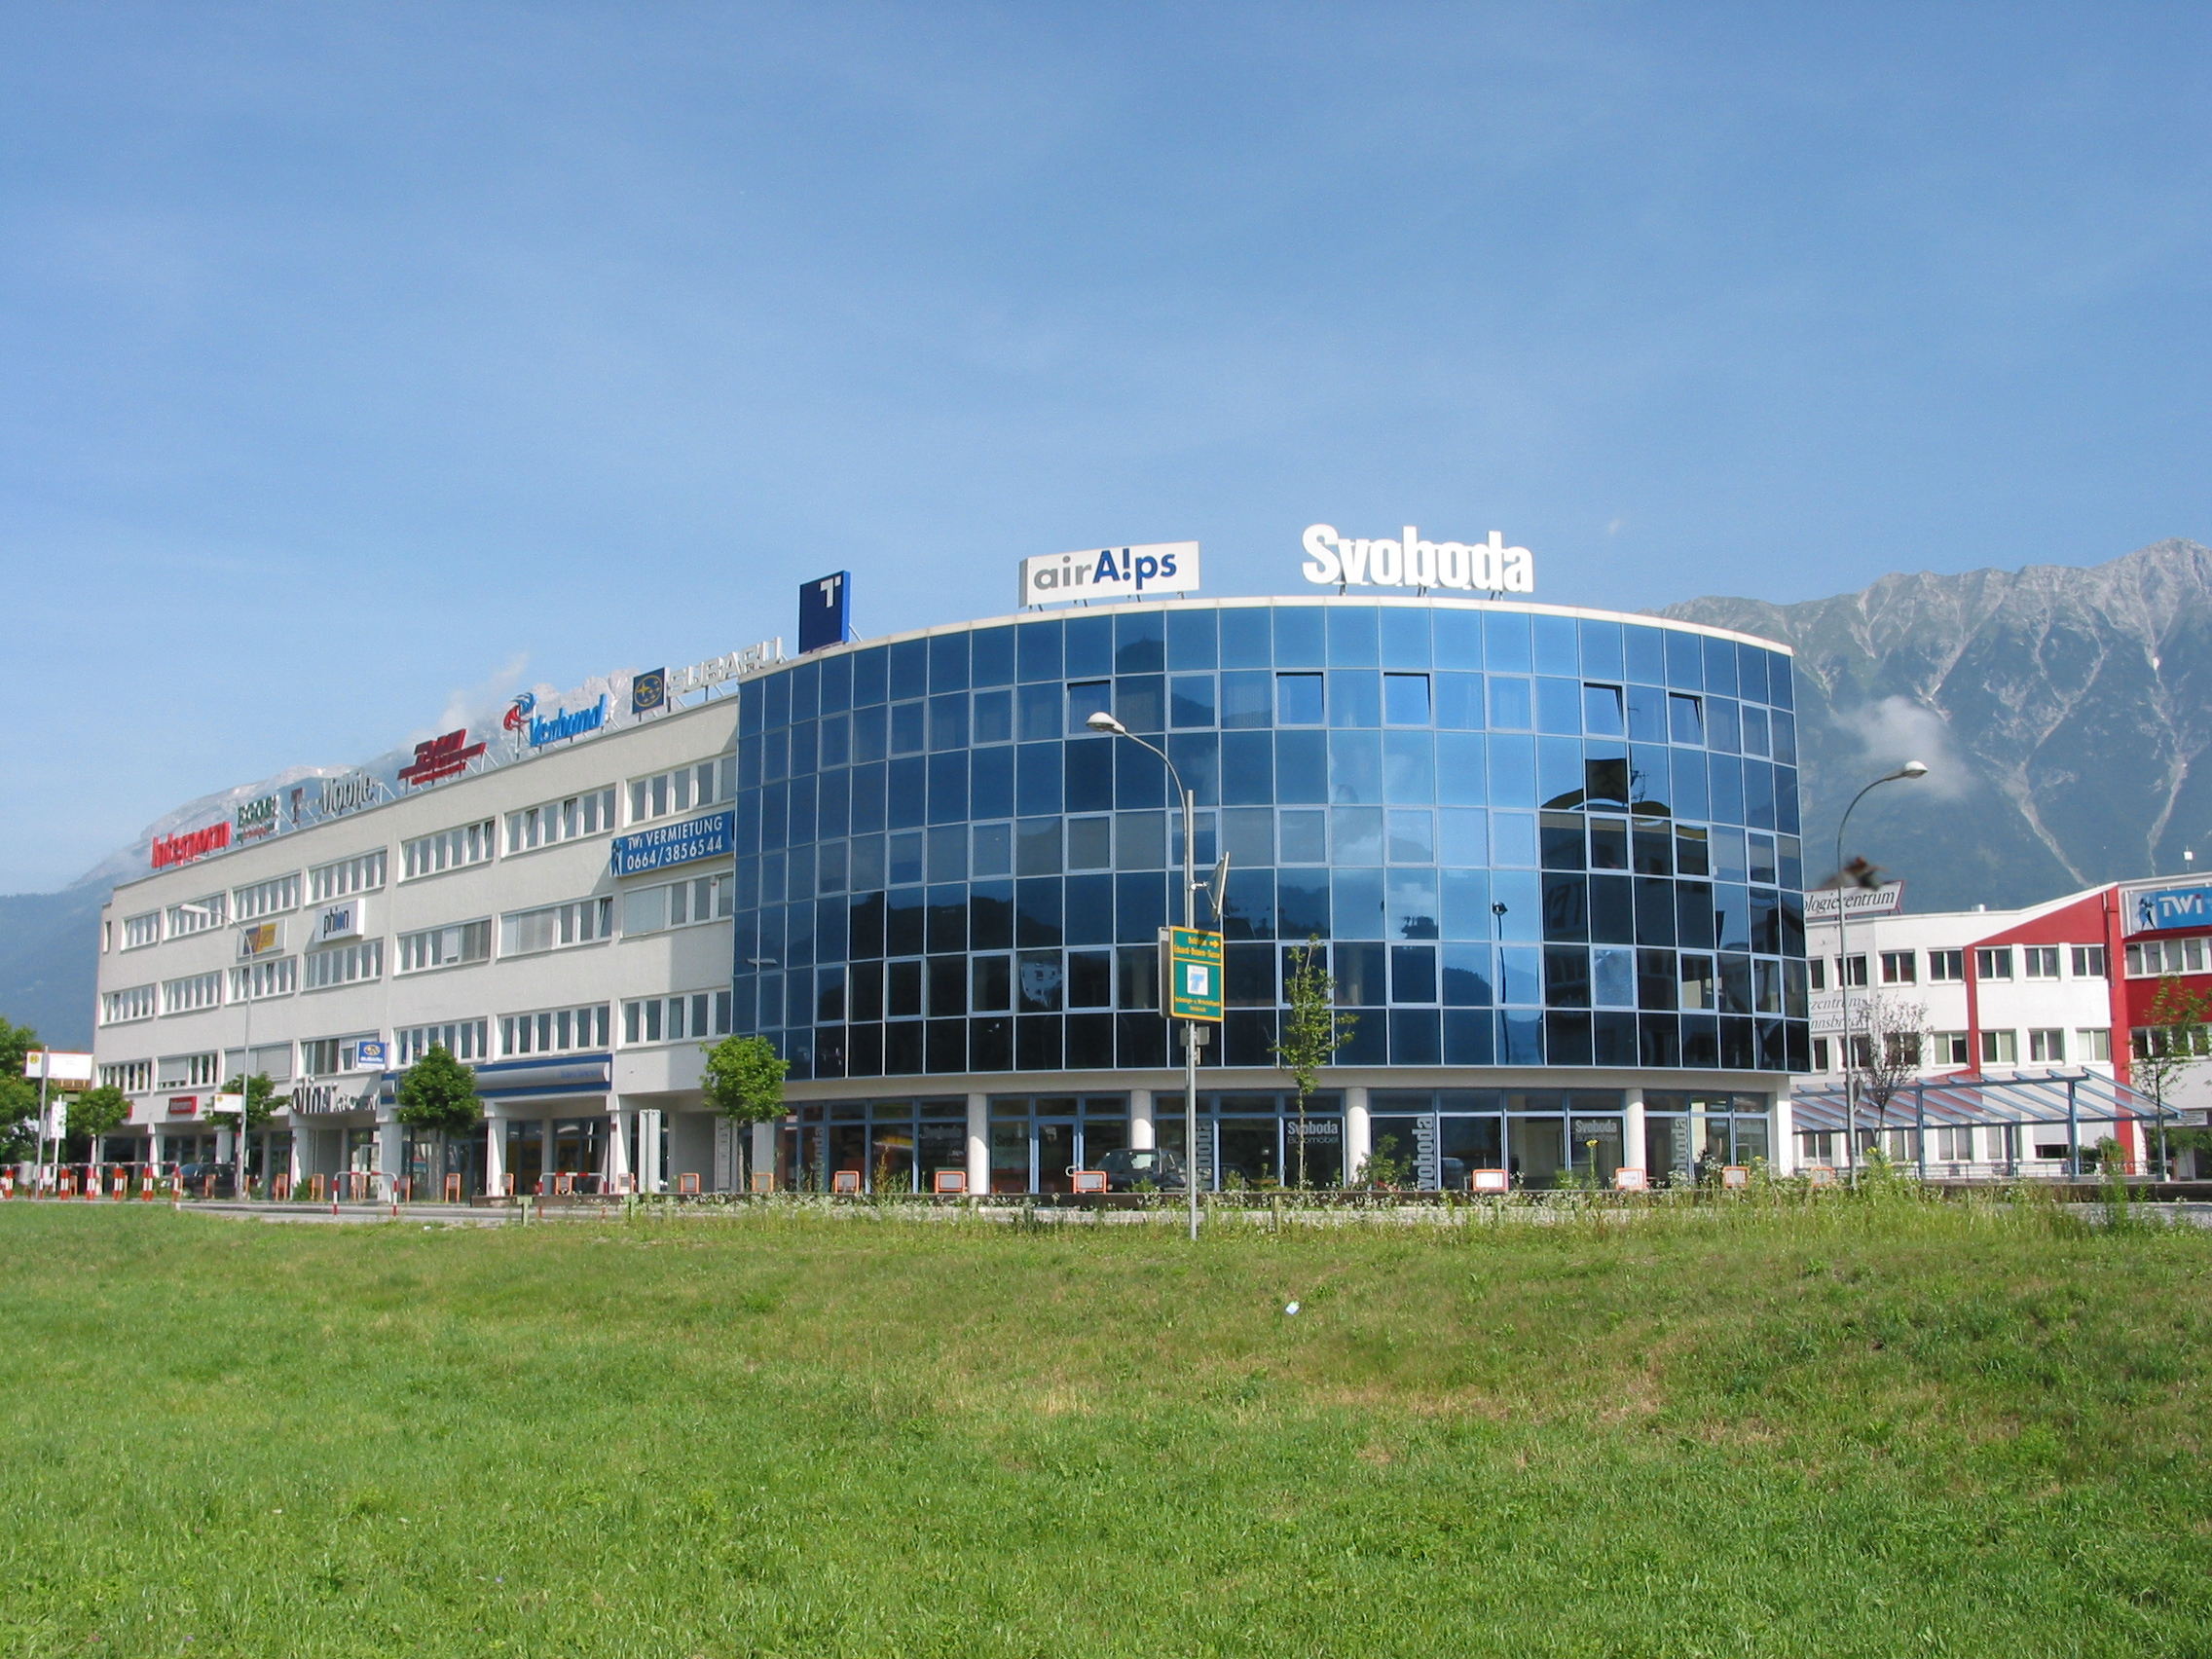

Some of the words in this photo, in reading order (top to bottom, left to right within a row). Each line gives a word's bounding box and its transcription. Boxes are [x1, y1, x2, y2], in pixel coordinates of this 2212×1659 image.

[1302, 524, 1534, 593] Svoboda
[645, 816, 722, 846] VERMIETUNG
[627, 835, 722, 870] 0664/3856544
[1575, 1120, 1617, 1133] Svoboda
